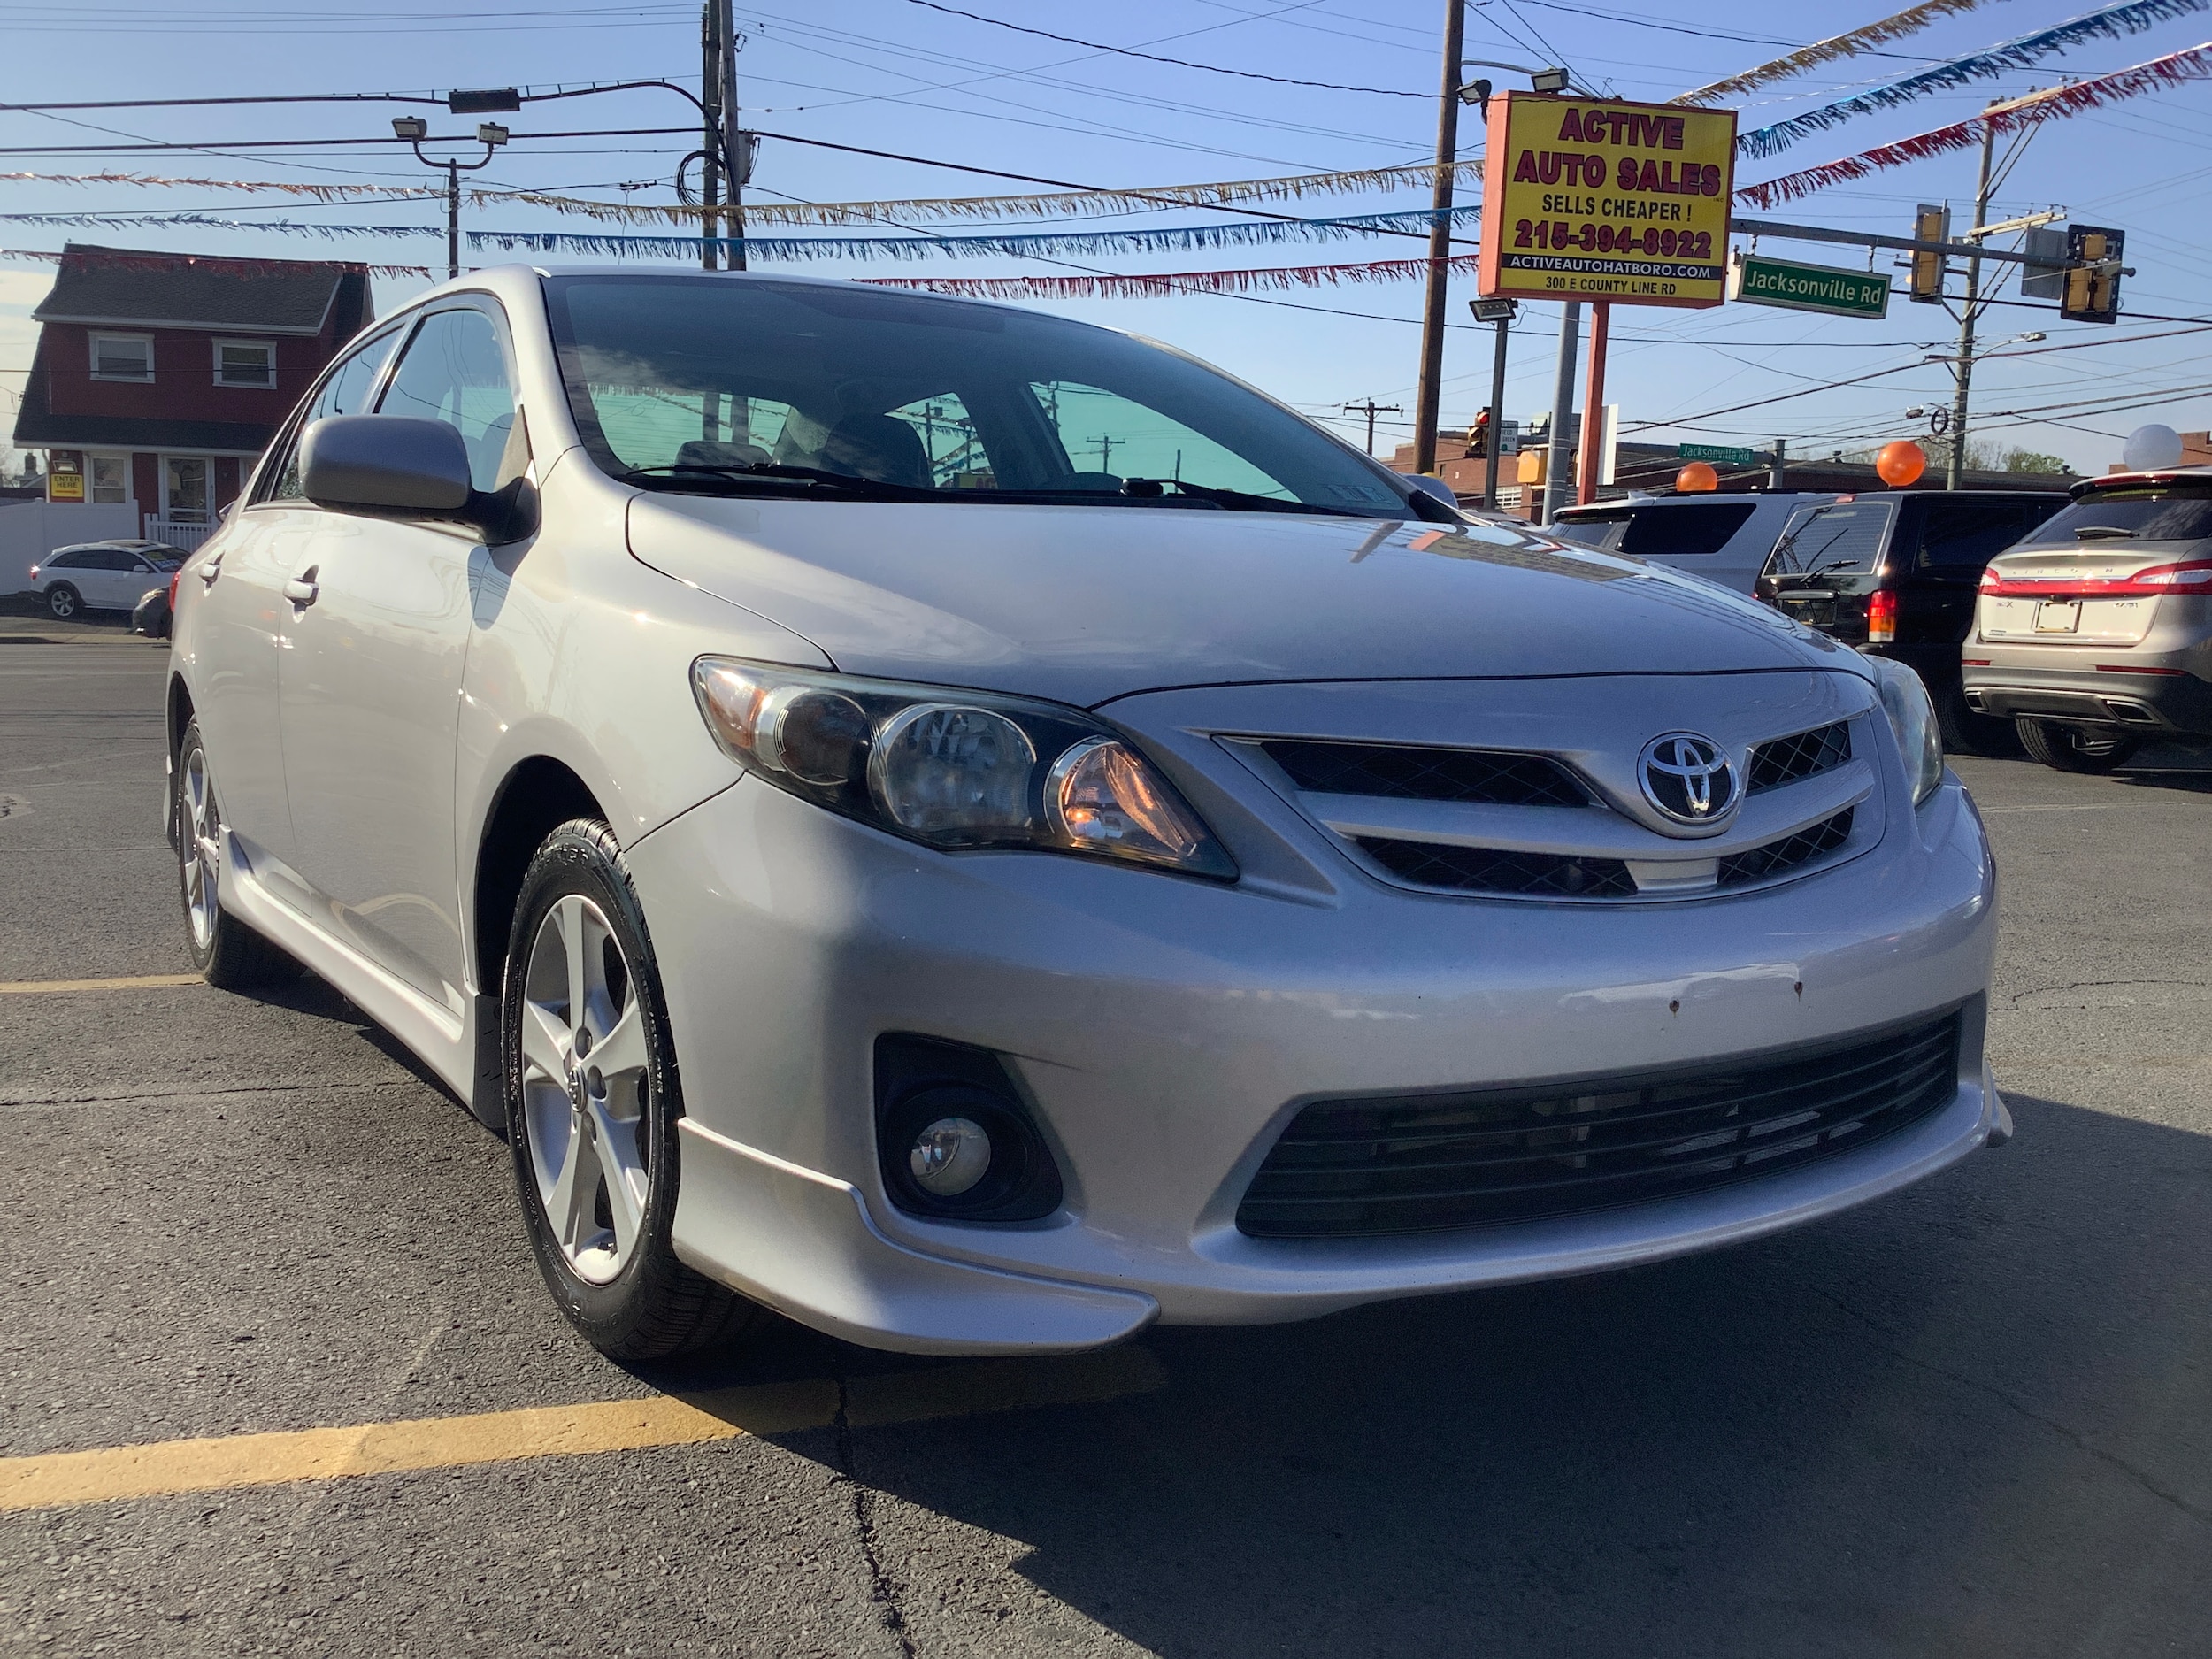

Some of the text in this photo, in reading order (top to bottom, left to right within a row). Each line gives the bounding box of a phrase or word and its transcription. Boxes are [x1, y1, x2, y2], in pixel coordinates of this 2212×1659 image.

[1558, 108, 1685, 150] ACTIVE
[1513, 150, 1721, 197] AUTO SALES
[1542, 194, 1595, 216] SELLS
[1601, 198, 1681, 221] CHEAPER
[1514, 219, 1712, 259] 215-394-8922
[1510, 256, 1711, 279] ACTIVEAUTOHATBORO.COM
[1546, 276, 1676, 295] 300 E COUNTY LINE RD
[1747, 270, 1882, 304] Jacksonville Rd
[1683, 445, 1750, 461] Jacksonville Rd
